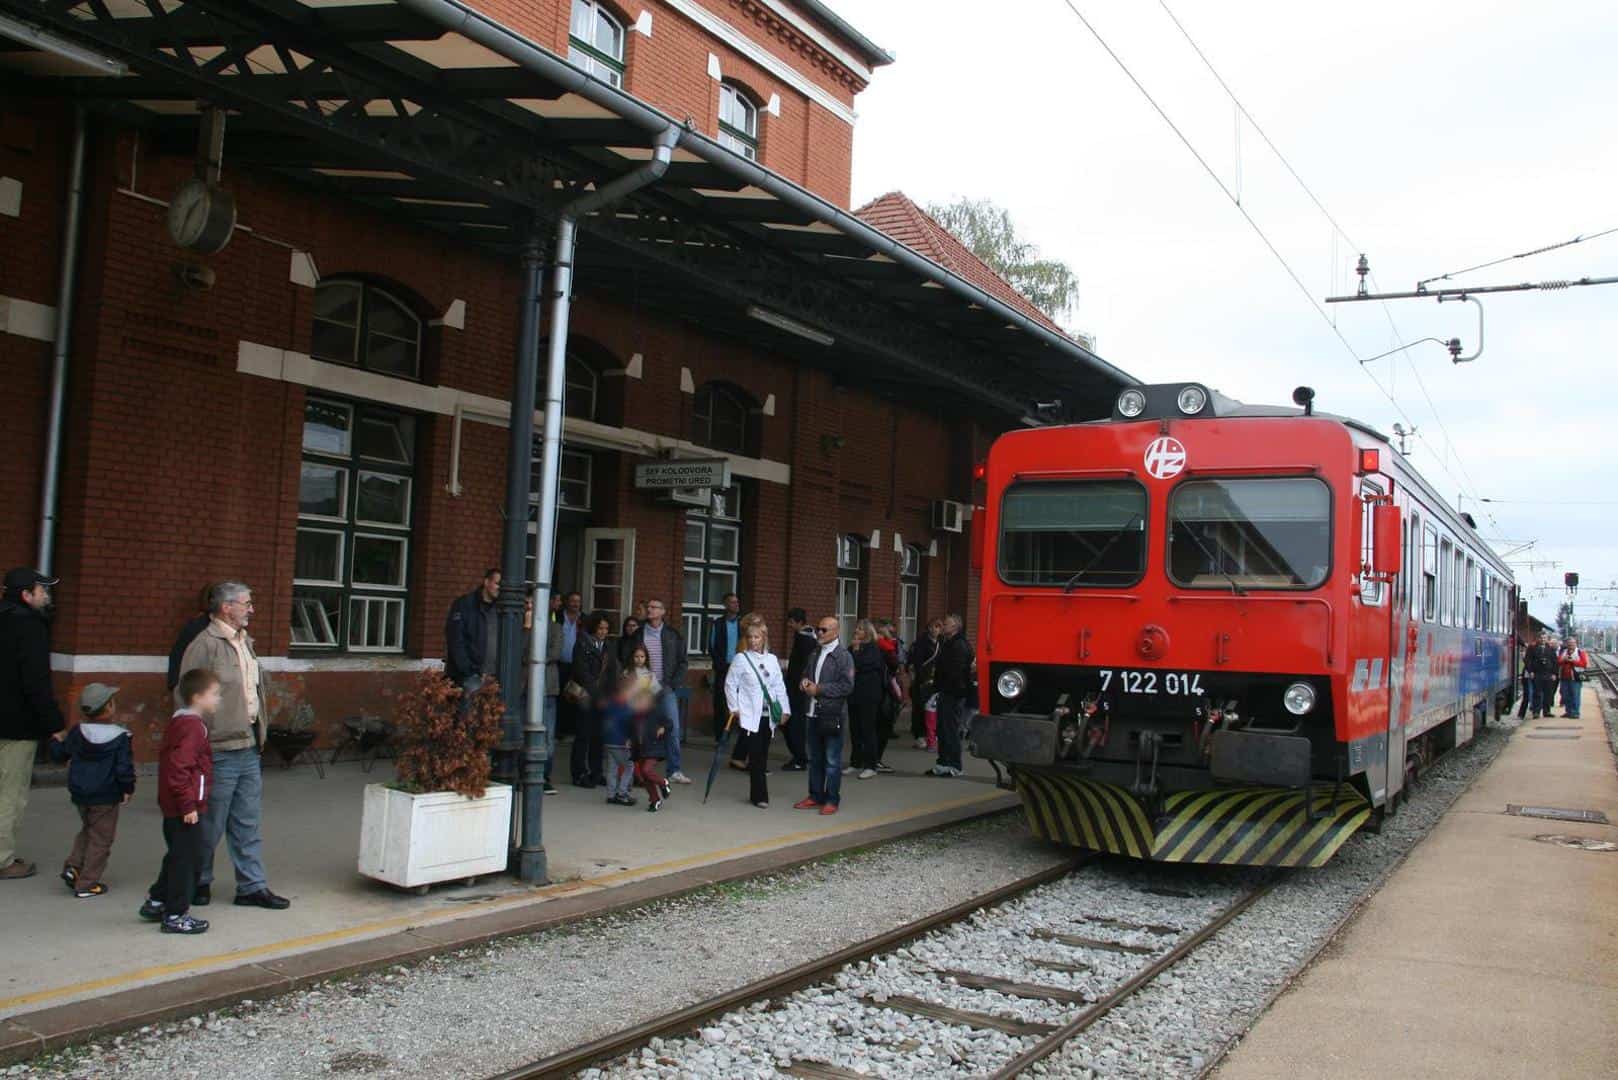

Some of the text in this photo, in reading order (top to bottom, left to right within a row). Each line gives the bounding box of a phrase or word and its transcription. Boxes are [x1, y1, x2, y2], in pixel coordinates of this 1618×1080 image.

[688, 476, 712, 485] URED
[1100, 670, 1205, 696] 7 122 014
